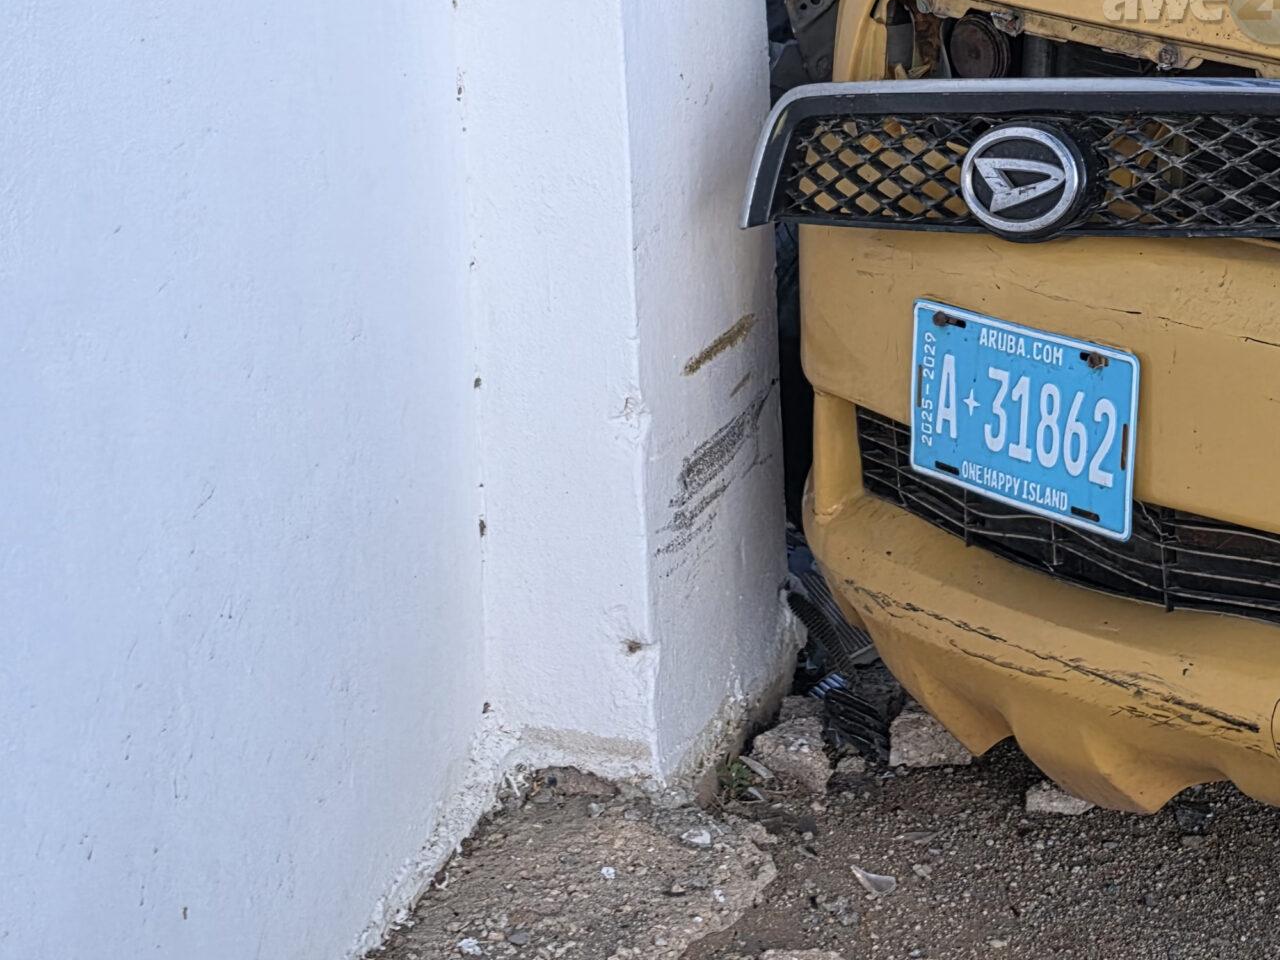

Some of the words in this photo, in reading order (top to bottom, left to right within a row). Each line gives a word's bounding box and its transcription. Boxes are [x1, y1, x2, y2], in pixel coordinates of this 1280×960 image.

[979, 327, 1063, 366] ARUBA.COM
[935, 353, 957, 439] A
[984, 366, 1117, 488] 31862
[961, 460, 983, 484] ONE
[983, 467, 1021, 496] HAPPY
[1022, 480, 1068, 512] ISLAND
